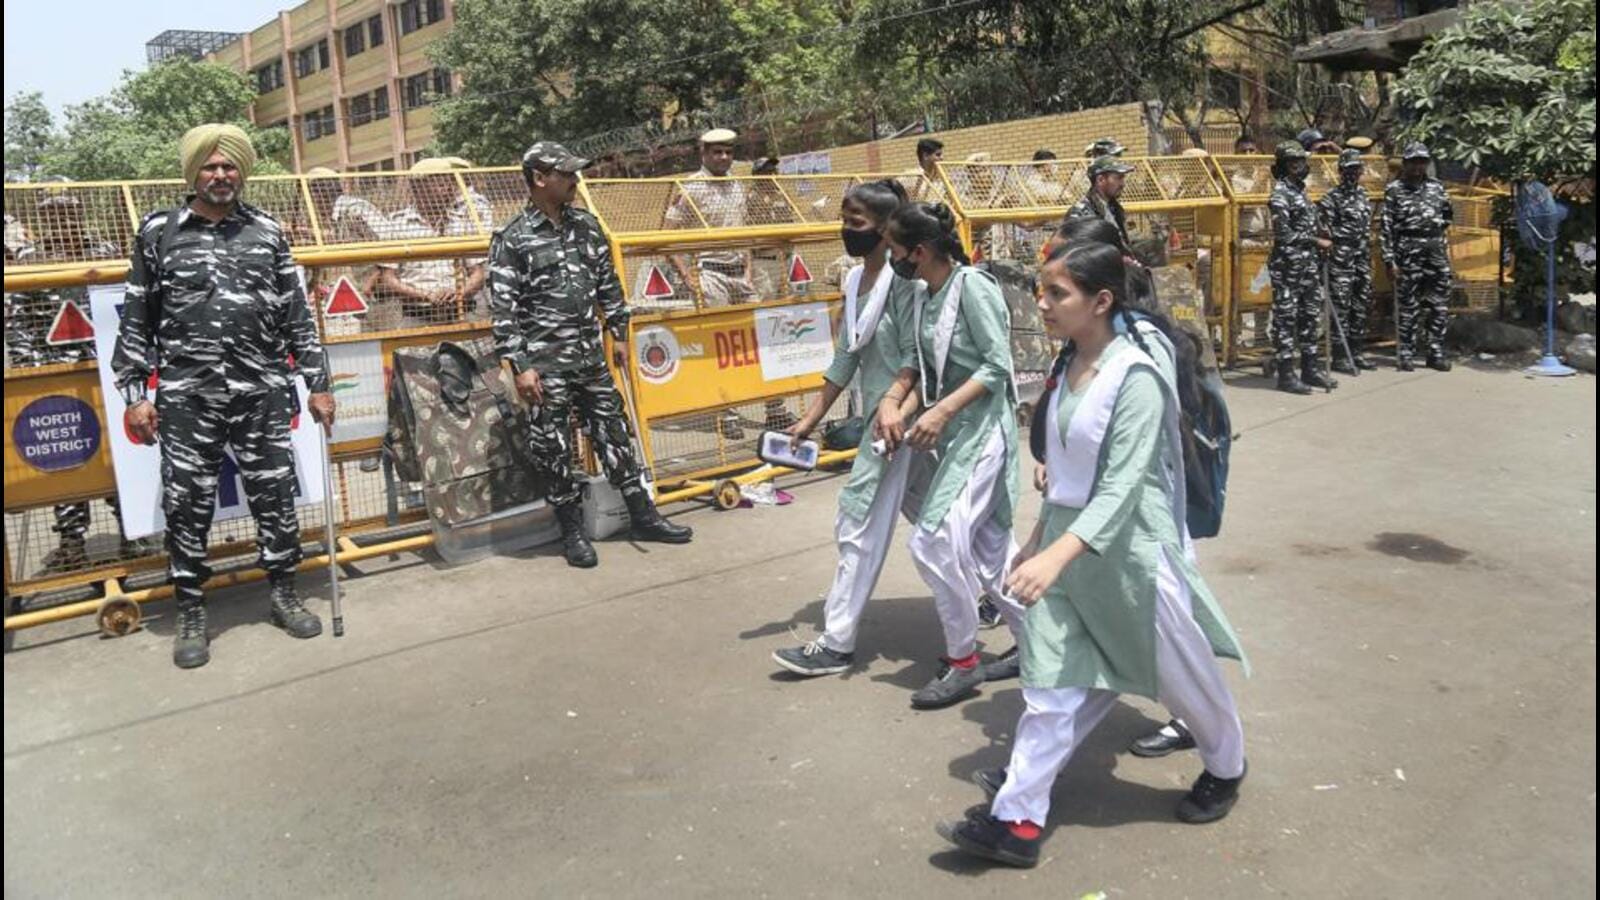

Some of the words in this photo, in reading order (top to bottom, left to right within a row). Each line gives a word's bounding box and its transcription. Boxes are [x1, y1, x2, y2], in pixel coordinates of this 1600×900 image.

[29, 411, 82, 428] NORTH
[35, 425, 79, 441] WEST
[25, 438, 93, 458] DISTRICT
